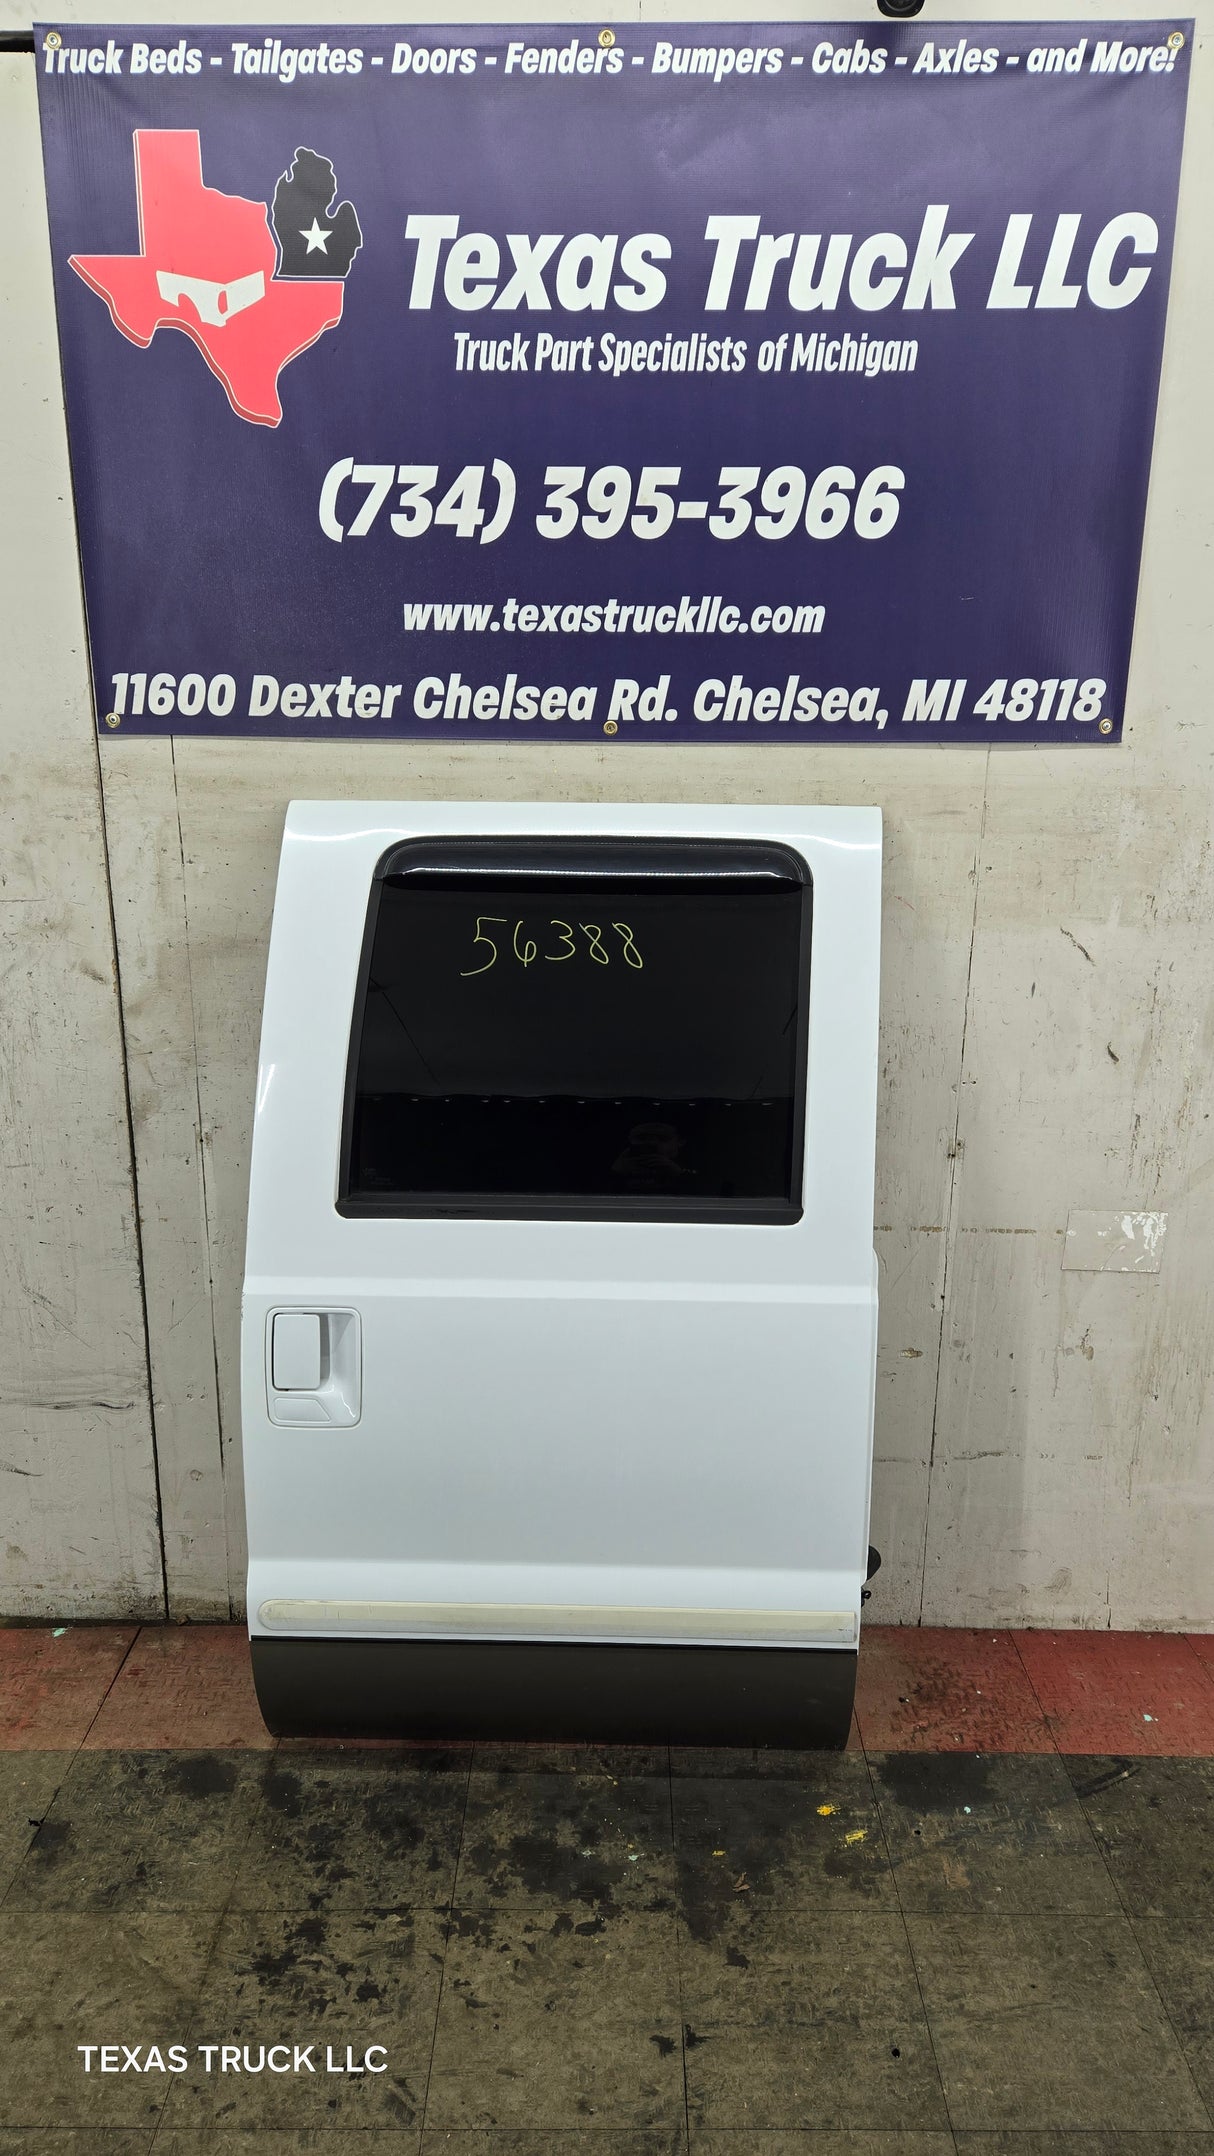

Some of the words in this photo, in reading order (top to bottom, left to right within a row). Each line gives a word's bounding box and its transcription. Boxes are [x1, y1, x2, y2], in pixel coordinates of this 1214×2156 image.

[42, 40, 124, 74] Truck
[130, 40, 203, 74] Beds
[210, 57, 222, 65] -
[231, 38, 364, 83] Tailgates
[371, 57, 383, 65] -
[392, 42, 477, 74] Doors
[484, 57, 497, 65] -
[504, 39, 625, 74] Fenders
[632, 57, 645, 65] -
[651, 42, 784, 83] Bumpers
[791, 57, 804, 65] -
[811, 40, 888, 74] Cabs
[894, 56, 908, 65] -
[912, 39, 1000, 73] Axles
[1006, 56, 1020, 65] -
[1027, 39, 1089, 73] and
[1090, 41, 1179, 73] More!
[404, 214, 672, 312] Texas
[704, 204, 976, 312] Truck
[985, 211, 1159, 310] LLC
[454, 332, 531, 372] Truck
[534, 332, 595, 372] Part
[598, 332, 748, 378] Specialists
[757, 333, 789, 372] of
[790, 332, 919, 378] Michigan
[318, 456, 516, 545] (734)
[535, 465, 906, 540] 395-3966
[403, 596, 826, 633] www.texastruckllc.com
[111, 673, 236, 716] 11600
[248, 674, 403, 719] Dexter
[413, 673, 598, 721] Chelsea
[607, 679, 678, 722] Rd.
[693, 675, 889, 730] Chelsea,
[901, 679, 968, 722] MI
[972, 678, 1107, 722] 48118
[459, 916, 643, 977] 56388
